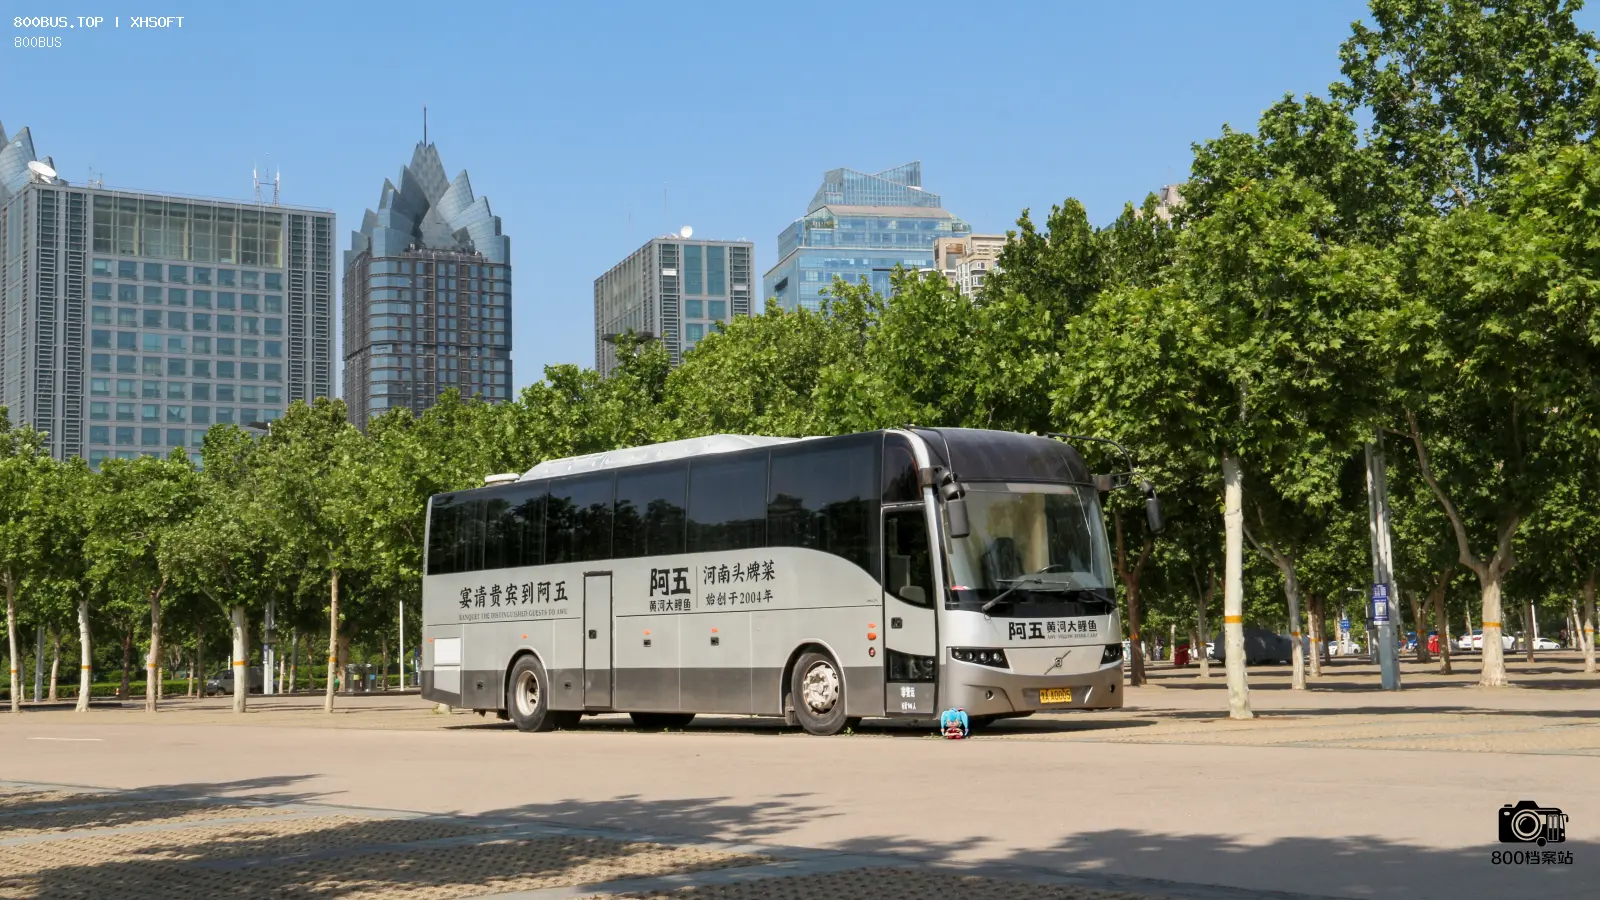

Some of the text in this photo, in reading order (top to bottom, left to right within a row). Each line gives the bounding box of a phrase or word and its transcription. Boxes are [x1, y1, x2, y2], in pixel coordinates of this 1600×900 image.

[649, 566, 691, 597] 阿五
[703, 559, 776, 585] 河南头牌菜
[459, 580, 569, 609] 宴请贵宾到阿五
[705, 589, 774, 606] 始创于2004年
[481, 612, 490, 620] THE
[528, 608, 547, 617] GUESTS
[649, 598, 691, 613] 黄河大鲤鱼
[1008, 620, 1098, 641] 阿五 黄河大鲤鱼
